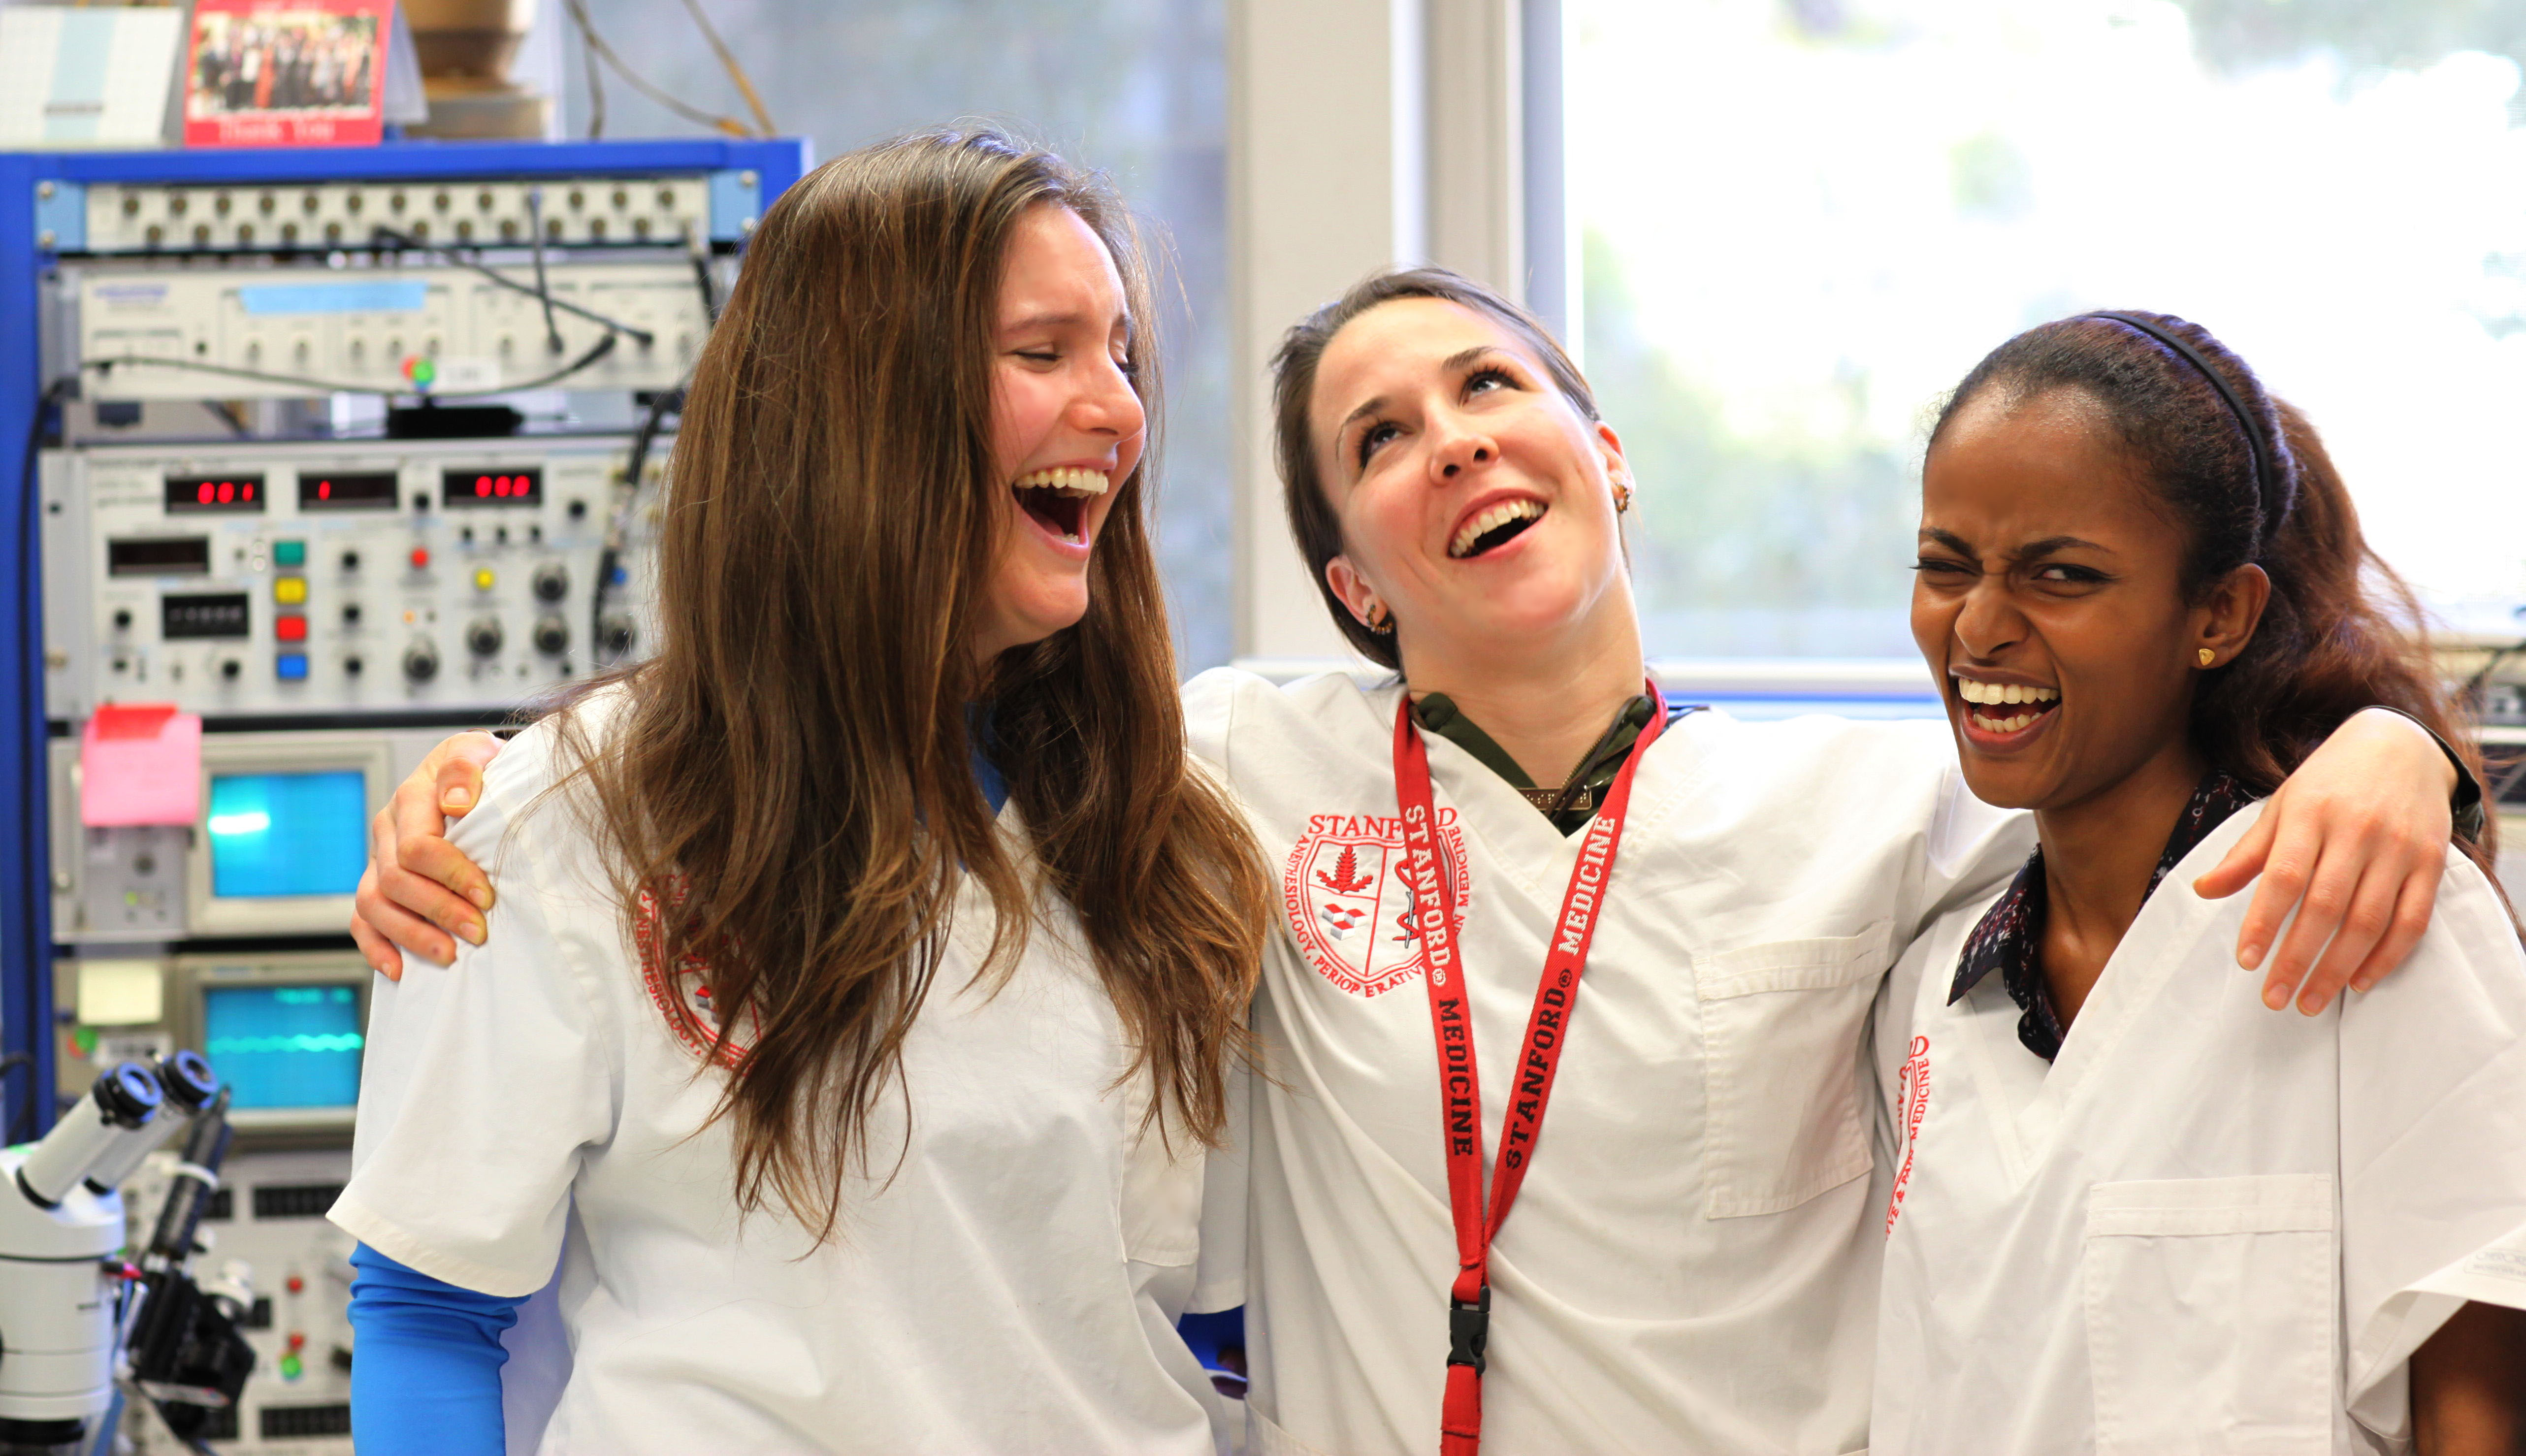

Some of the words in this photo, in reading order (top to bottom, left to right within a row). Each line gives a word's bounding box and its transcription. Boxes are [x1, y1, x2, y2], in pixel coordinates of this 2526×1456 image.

[1308, 808, 1457, 839] STANFD
[1449, 826, 1470, 907] MEDICINE
[1557, 816, 1616, 956] MEDICINE
[1438, 998, 1473, 1156] MEDICINE
